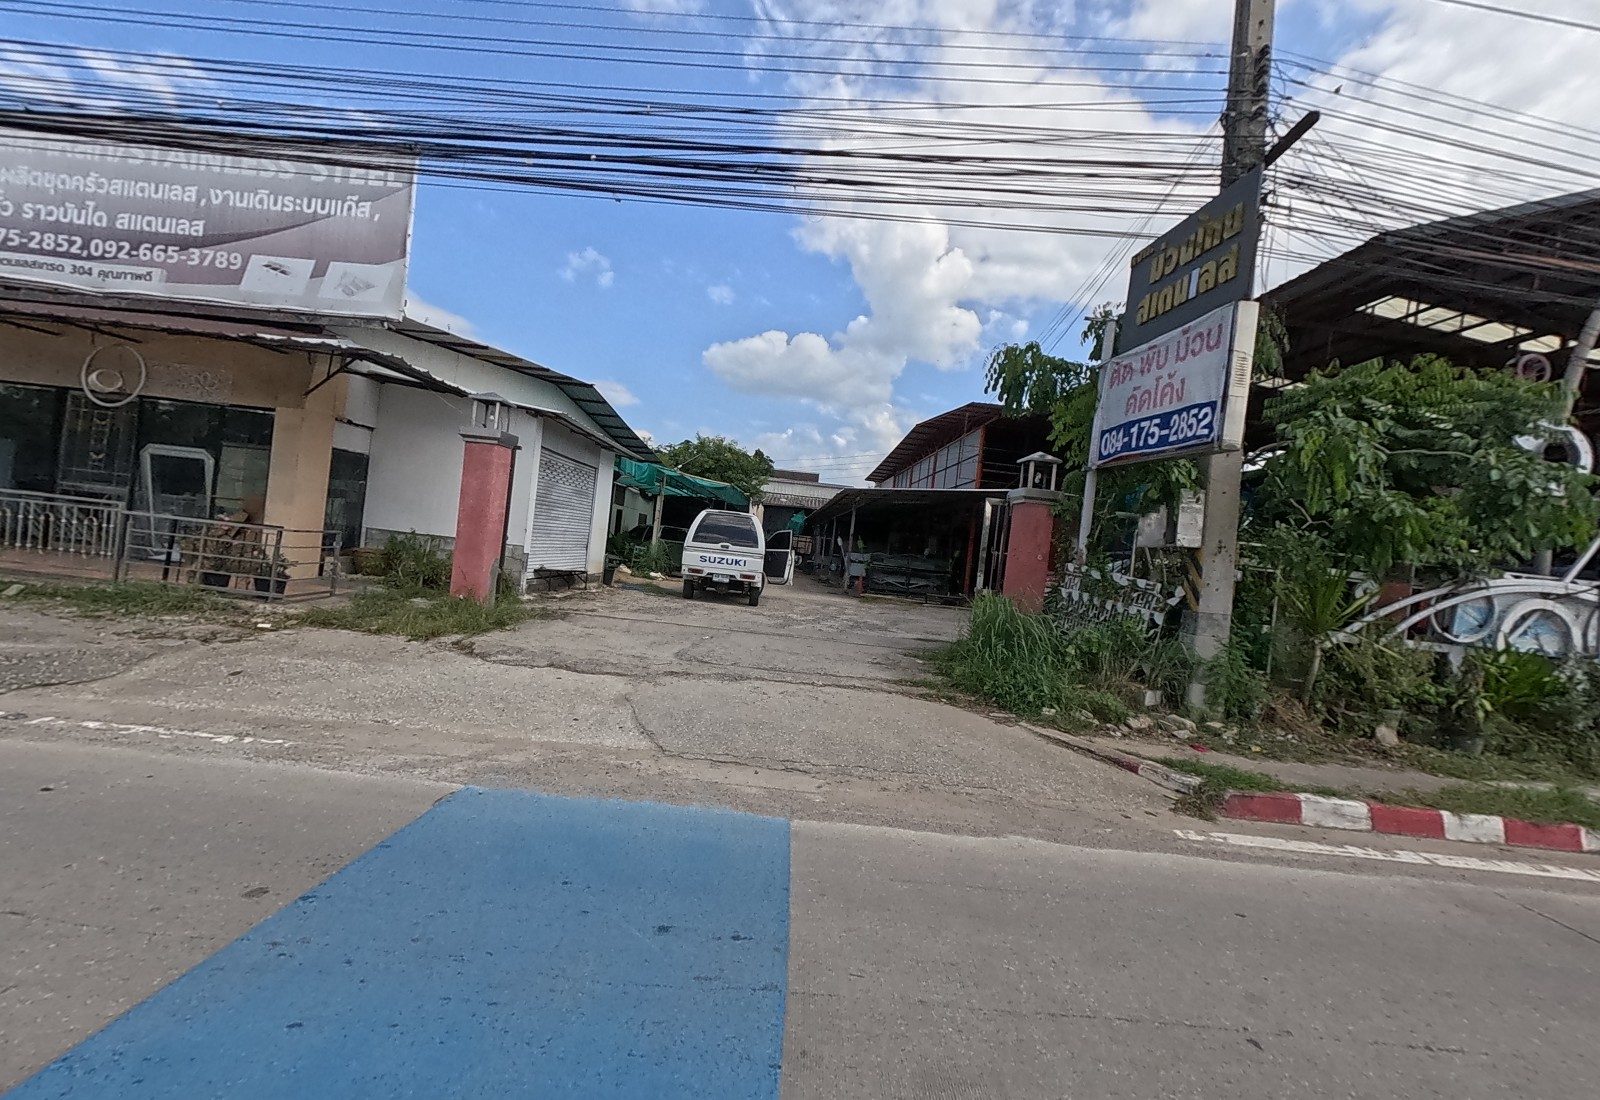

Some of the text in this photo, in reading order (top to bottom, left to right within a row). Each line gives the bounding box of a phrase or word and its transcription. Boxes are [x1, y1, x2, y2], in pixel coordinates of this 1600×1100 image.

[22, 201, 107, 228] ราวบันได
[115, 212, 206, 237] สแตนเลส
[70, 263, 93, 277] 304
[1100, 406, 1213, 457] 084-175-2852
[699, 555, 747, 567] SUZUKI
